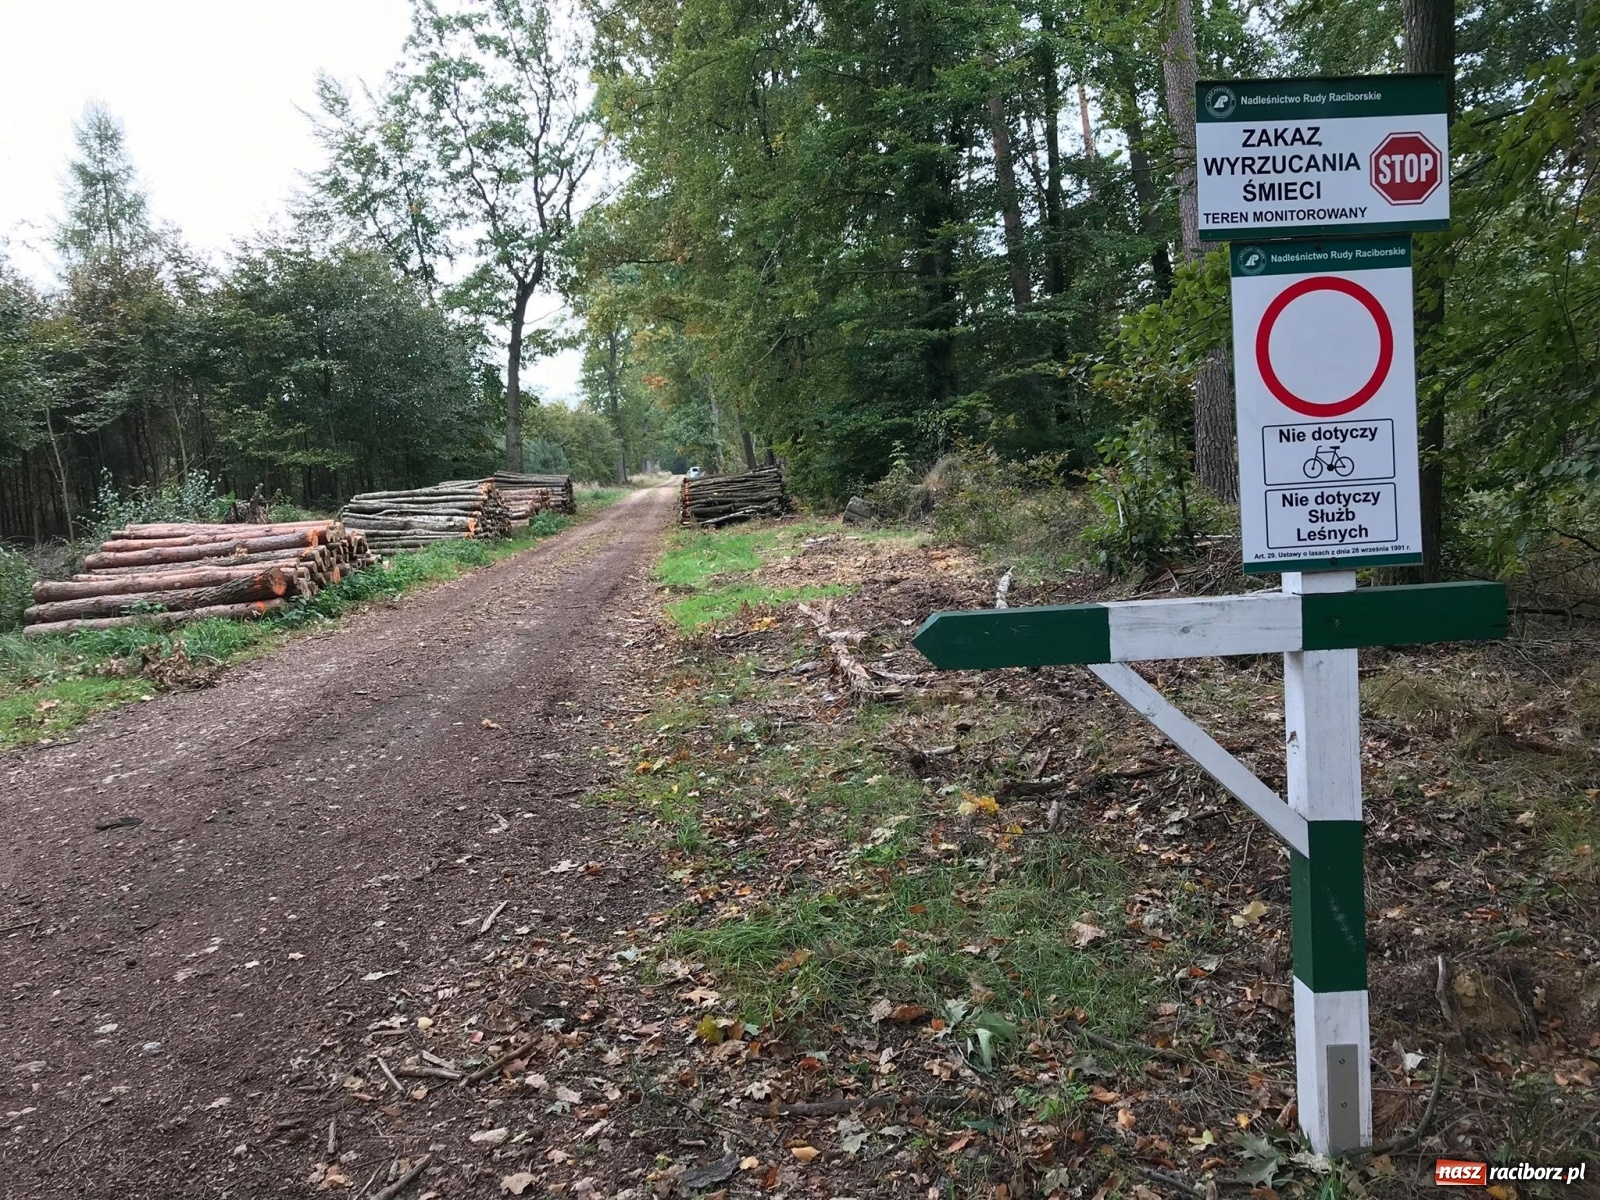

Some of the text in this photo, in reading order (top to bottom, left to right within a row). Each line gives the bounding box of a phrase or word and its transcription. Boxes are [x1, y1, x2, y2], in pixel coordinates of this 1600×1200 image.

[1240, 91, 1382, 105] Nadleśnictwo Rudy Raciborskie
[1242, 126, 1321, 148] ZAKAZ
[1203, 152, 1361, 176] WYRZUCANIA
[1378, 152, 1434, 185] STOP
[1242, 179, 1322, 202] ŚMIECI
[1203, 206, 1368, 224] TEREN MONITOROWANY
[1270, 252, 1328, 263] Nadleśnictwo
[1330, 250, 1354, 260] Rudy
[1355, 246, 1406, 258] Raciborskie
[1278, 426, 1378, 444] Nie dotyczy
[1282, 490, 1381, 508] Nie dotyczy
[1308, 508, 1356, 524] Służb
[1296, 524, 1368, 543] Leśnych
